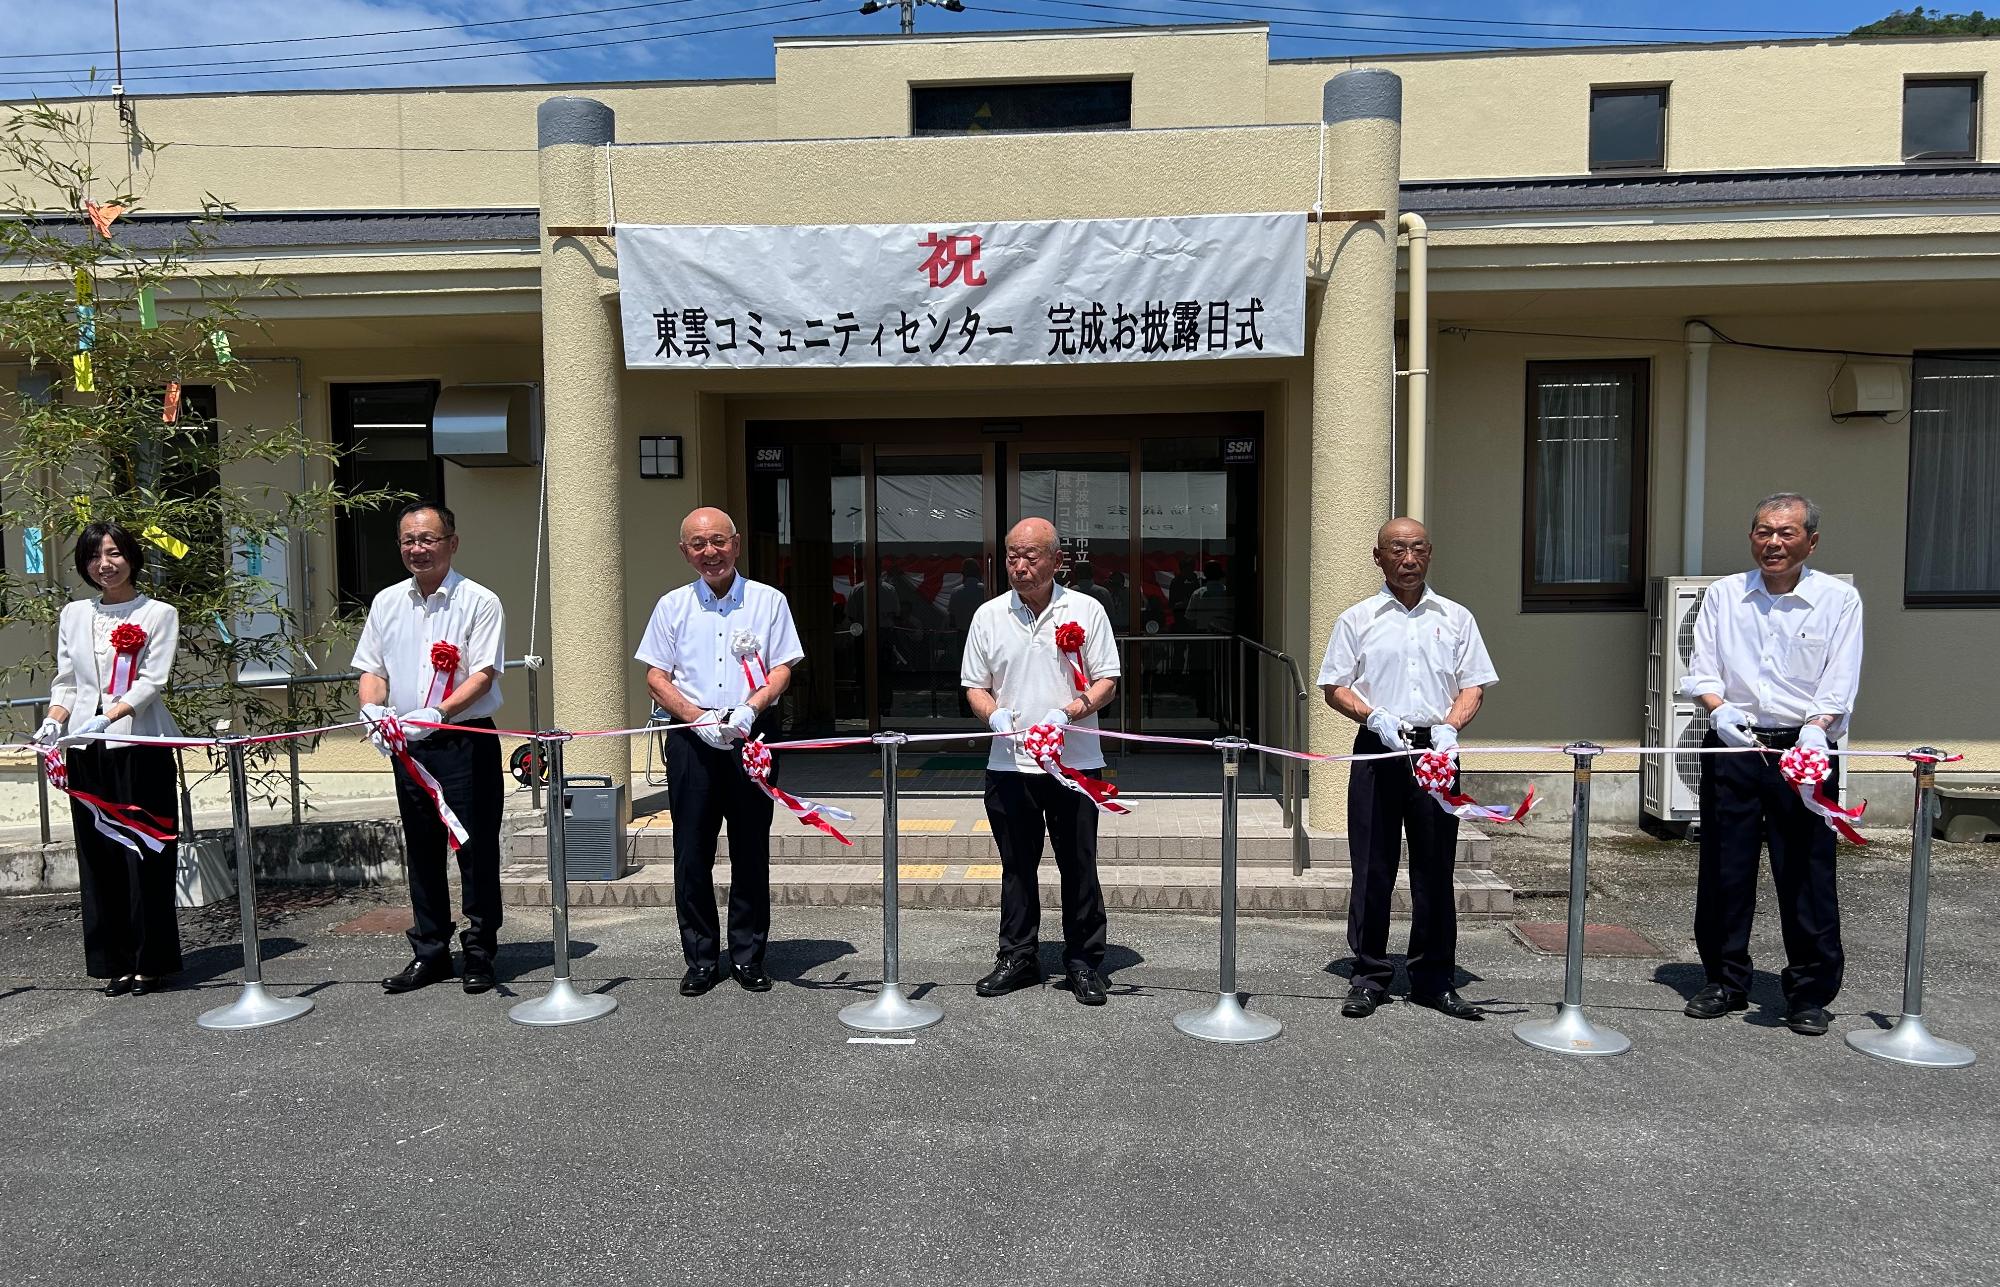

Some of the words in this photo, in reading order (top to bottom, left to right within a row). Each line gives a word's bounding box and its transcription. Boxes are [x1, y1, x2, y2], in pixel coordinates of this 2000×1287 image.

[917, 232, 988, 289] 祝
[652, 306, 1014, 359] 東雲コミュニティセンター
[1047, 297, 1265, 357] 完成お披露目式
[756, 449, 782, 461] SSN
[1226, 441, 1253, 453] SSN
[1075, 472, 1090, 563] 丹波篠山市立
